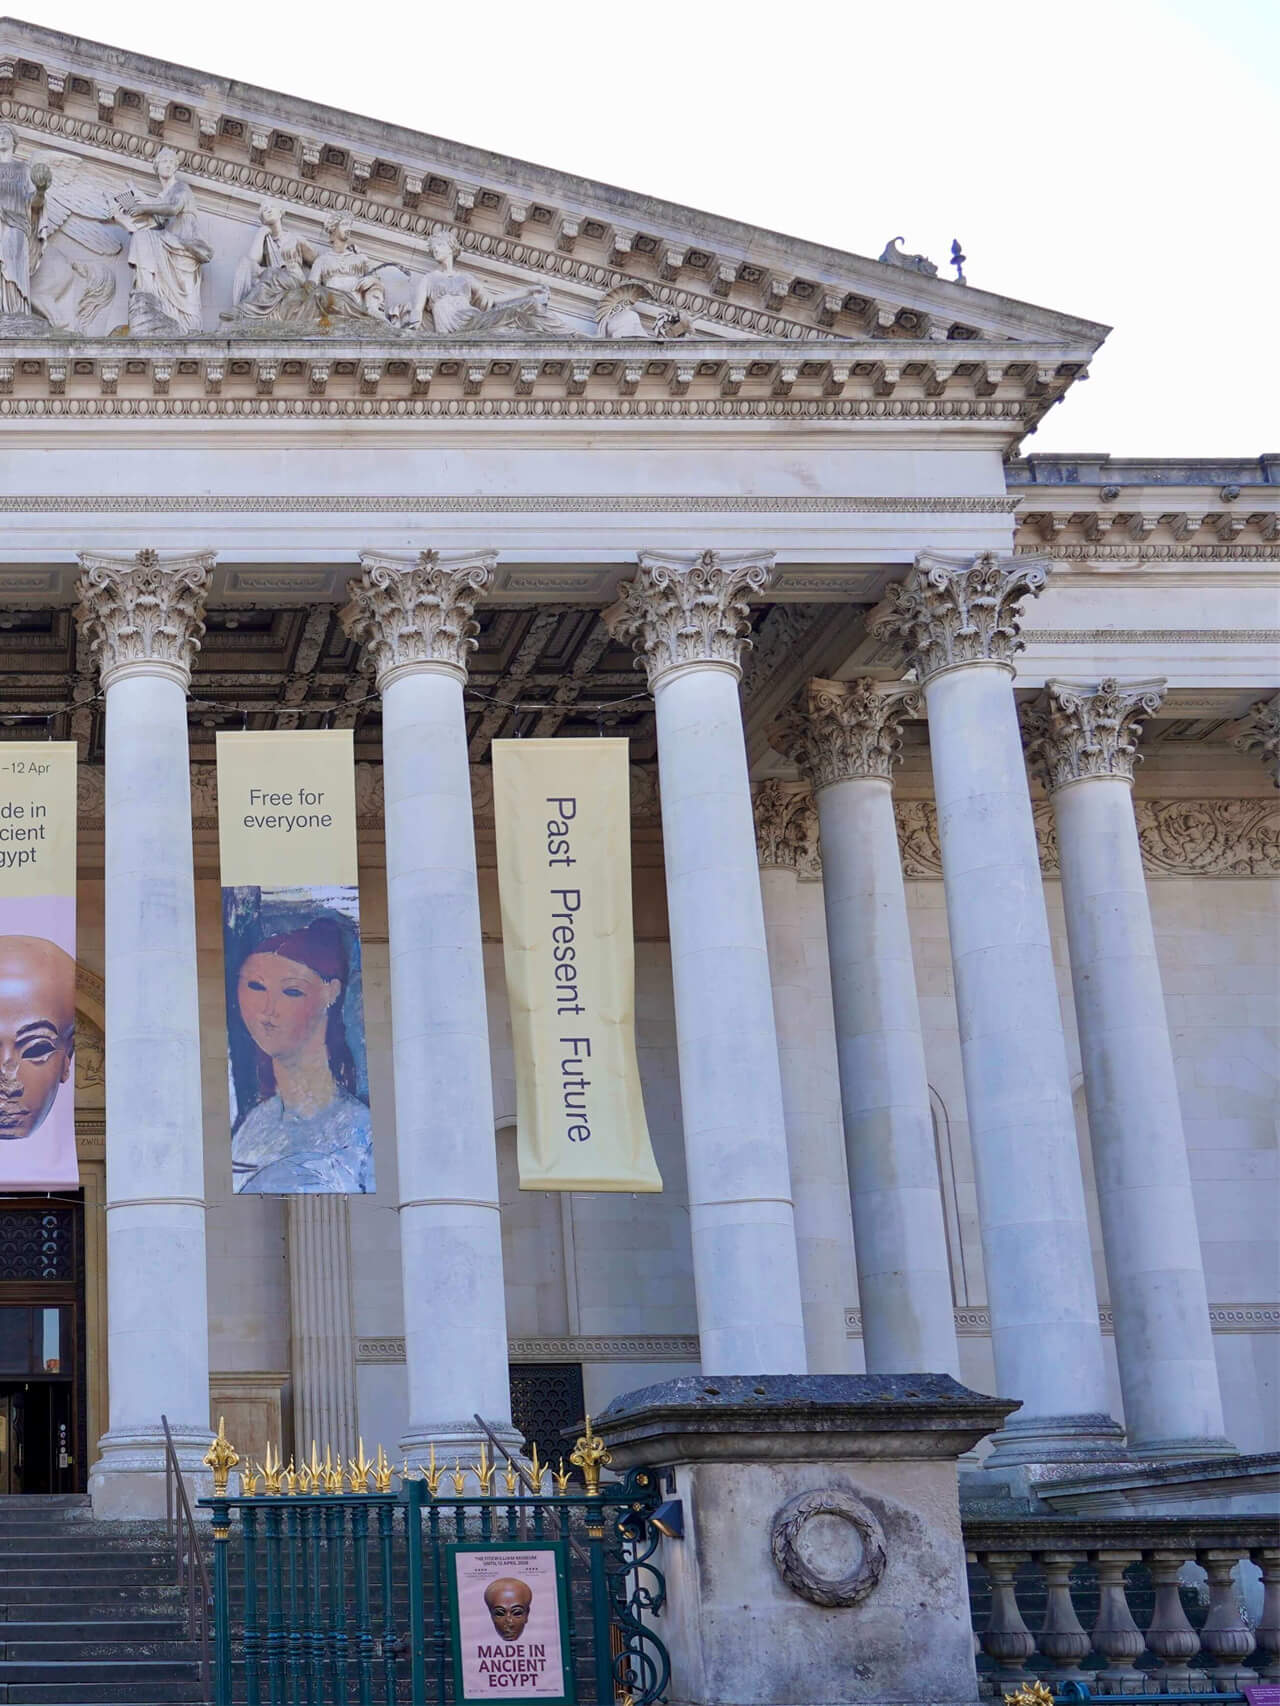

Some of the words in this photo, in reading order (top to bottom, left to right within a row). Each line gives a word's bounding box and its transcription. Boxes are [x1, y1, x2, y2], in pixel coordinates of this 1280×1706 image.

[28, 762, 51, 776] Apr
[250, 789, 293, 806] Free
[298, 788, 325, 806] for
[30, 801, 47, 818] in
[243, 814, 332, 833] everyone
[546, 797, 577, 868] Past
[550, 889, 586, 1016] Present
[559, 1037, 592, 1143] Future
[477, 1645, 525, 1658] MADE
[529, 1644, 545, 1658] IN
[478, 1659, 547, 1673] ANCIENT
[488, 1673, 539, 1688] EGYPT
